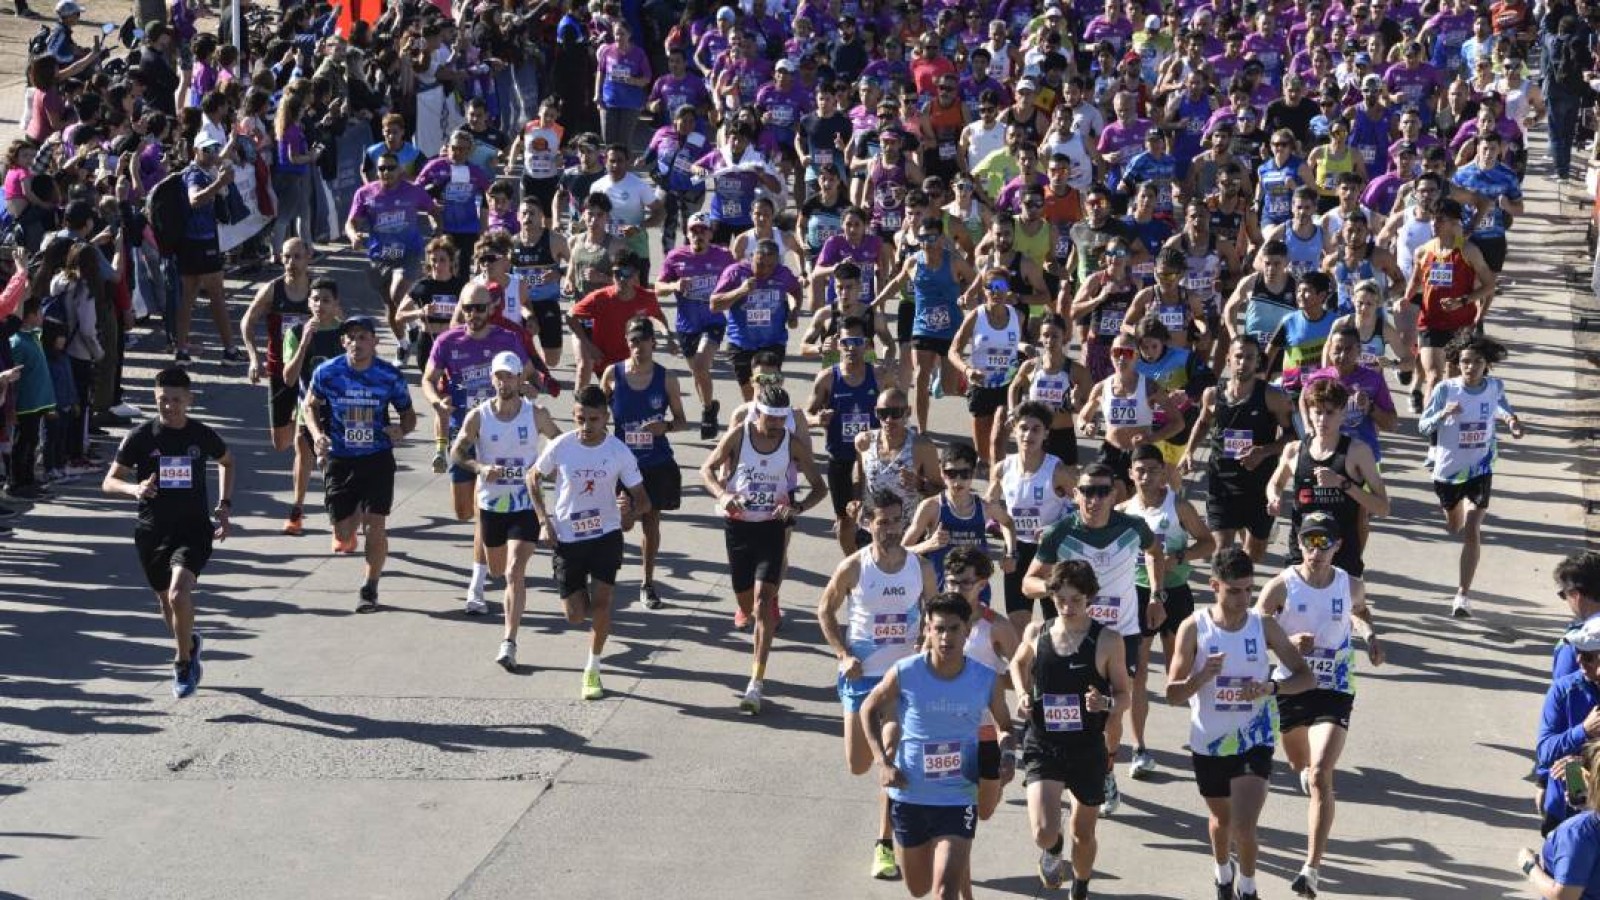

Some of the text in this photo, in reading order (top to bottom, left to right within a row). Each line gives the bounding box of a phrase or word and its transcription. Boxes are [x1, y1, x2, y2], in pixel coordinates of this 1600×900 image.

[1111, 408, 1136, 419] 870
[843, 422, 868, 435] 534
[346, 429, 373, 441] 605
[161, 468, 190, 478] 4944
[749, 491, 775, 505] 284
[572, 518, 601, 531] 3152
[1014, 519, 1038, 529] 1101
[882, 586, 906, 596] ARG
[875, 625, 906, 636] 6453
[1045, 708, 1079, 721] 4032
[925, 754, 961, 770] 3866
